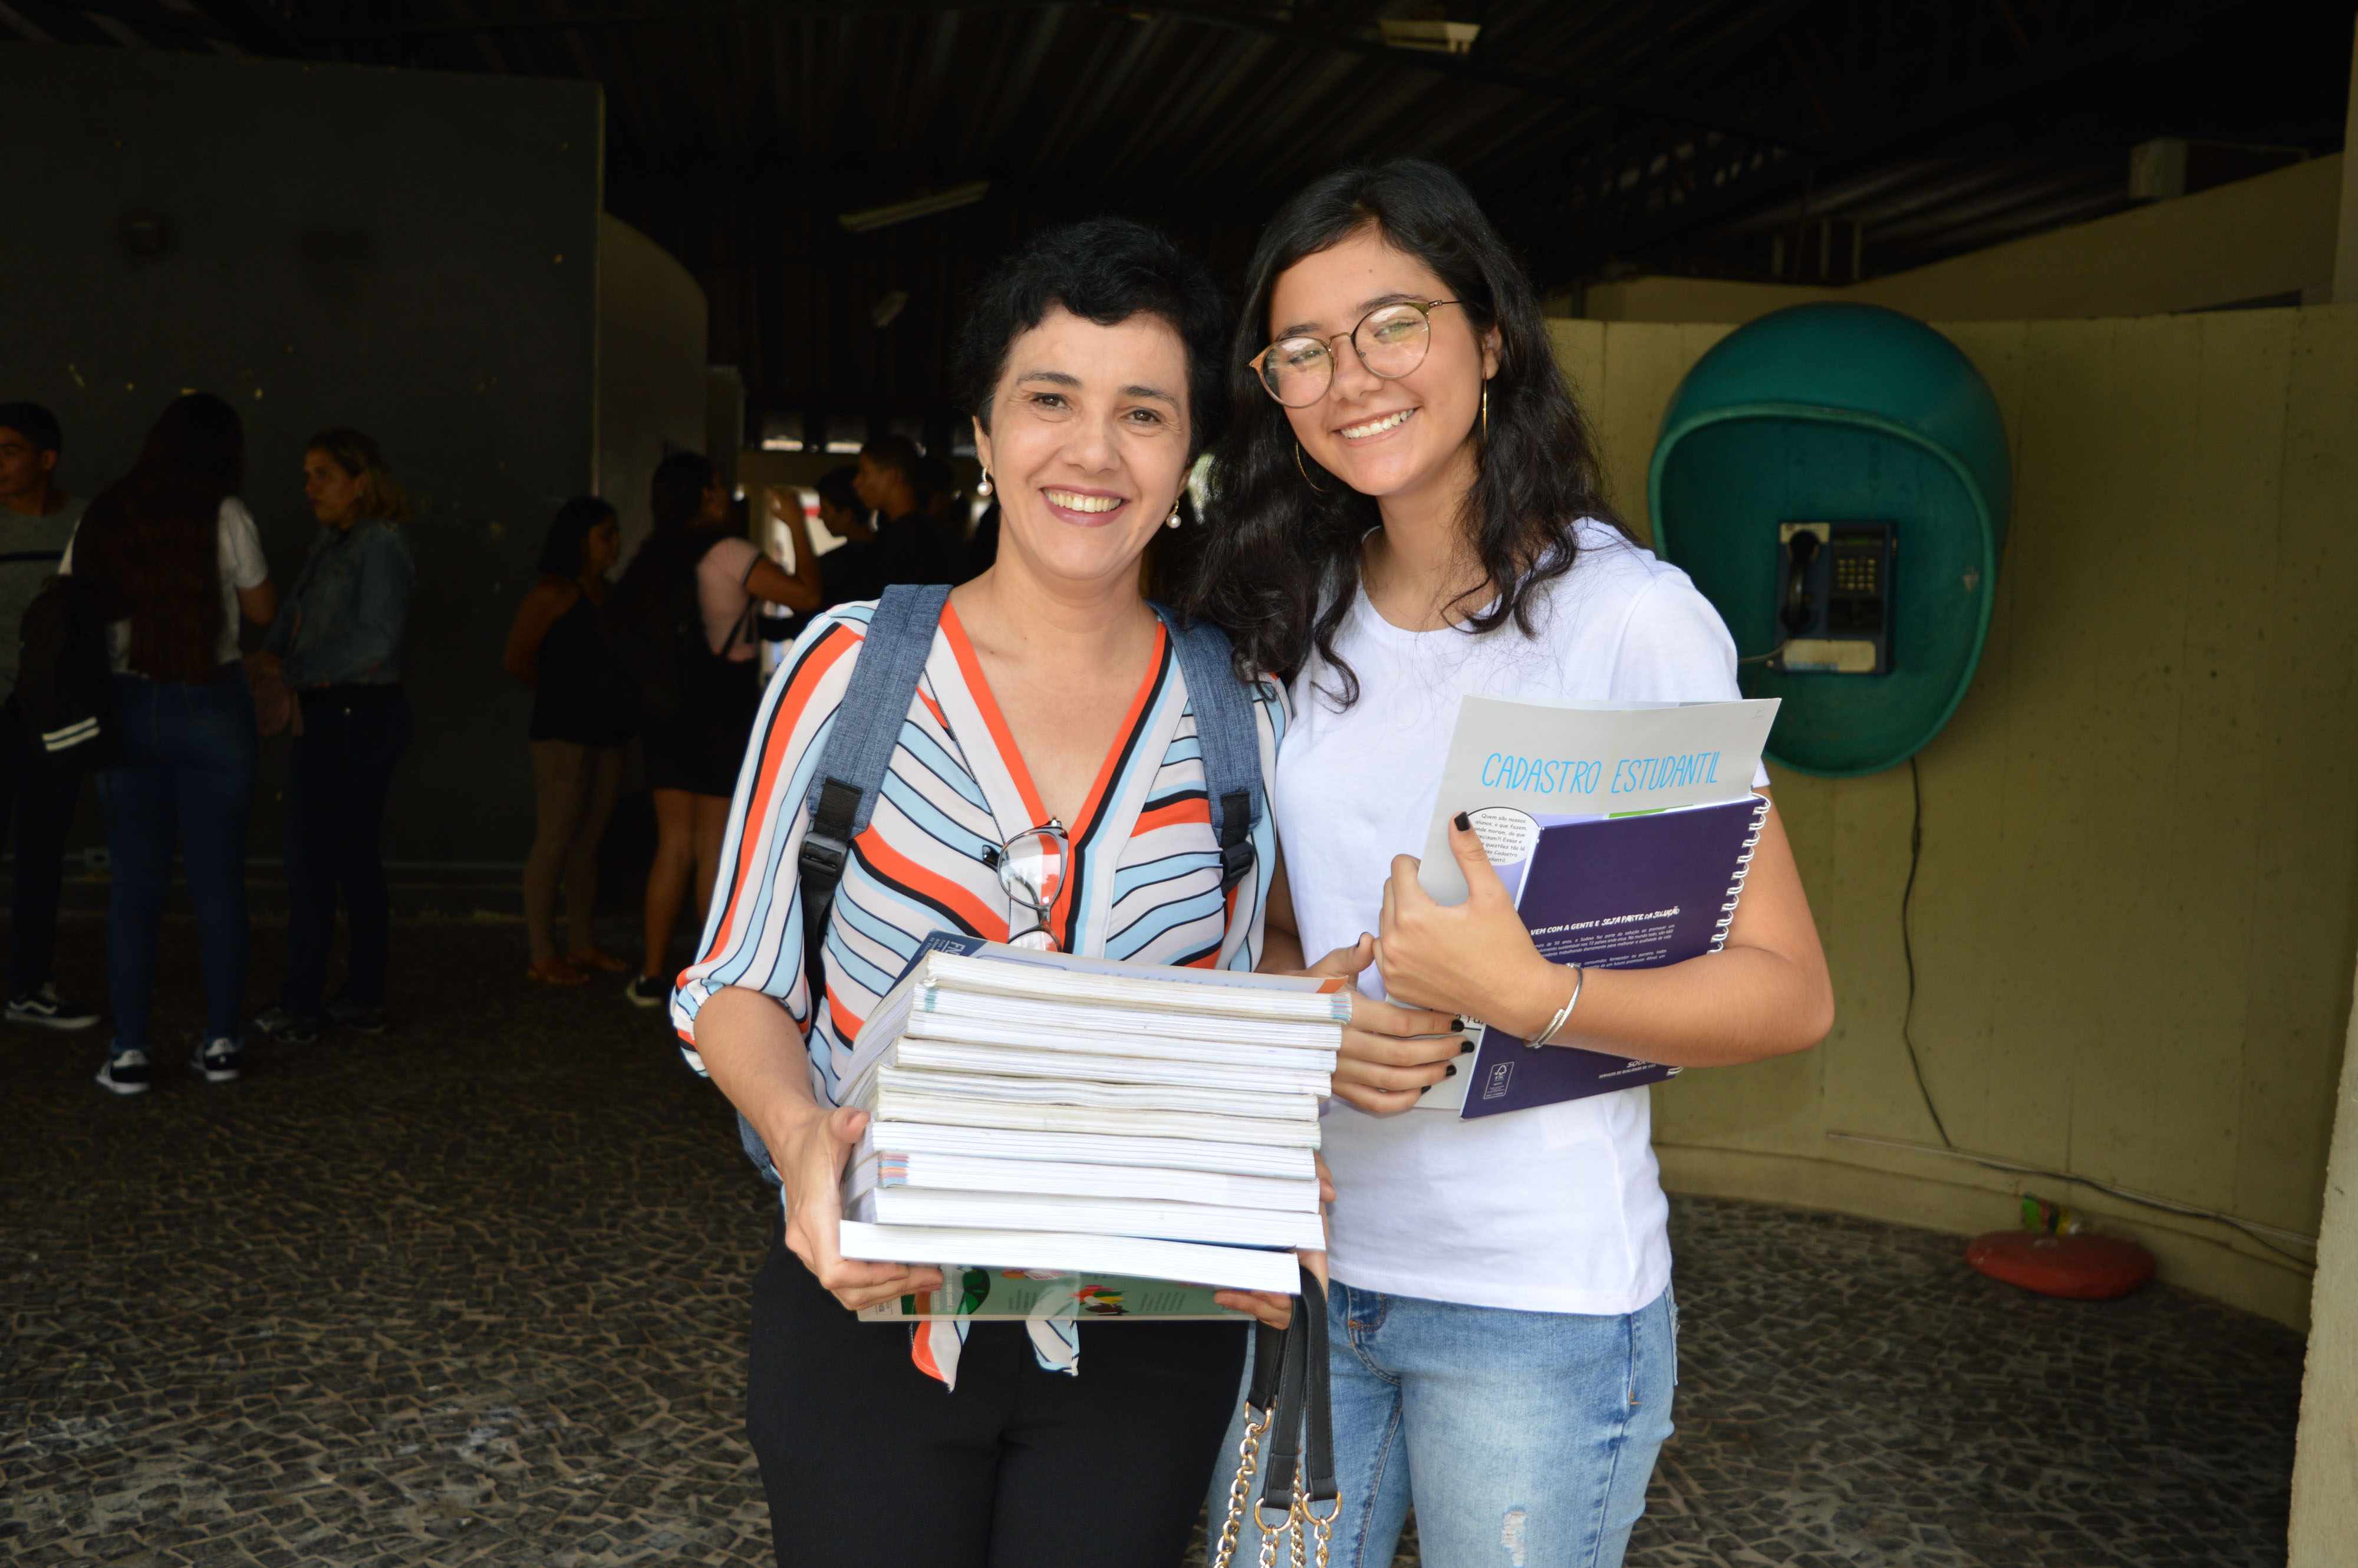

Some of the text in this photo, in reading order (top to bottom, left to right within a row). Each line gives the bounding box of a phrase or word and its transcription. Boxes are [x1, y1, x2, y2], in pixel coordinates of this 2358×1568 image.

[1482, 752, 1720, 794] CADASTRO ESTUDANTIL
[1531, 927, 1546, 935] VEM
[1547, 925, 1563, 933] COM
[1570, 921, 1595, 930] GENTE
[1601, 917, 1621, 925] SEJA
[1621, 914, 1643, 923] PARTE
[1653, 907, 1679, 918] SOLUÇÃO
